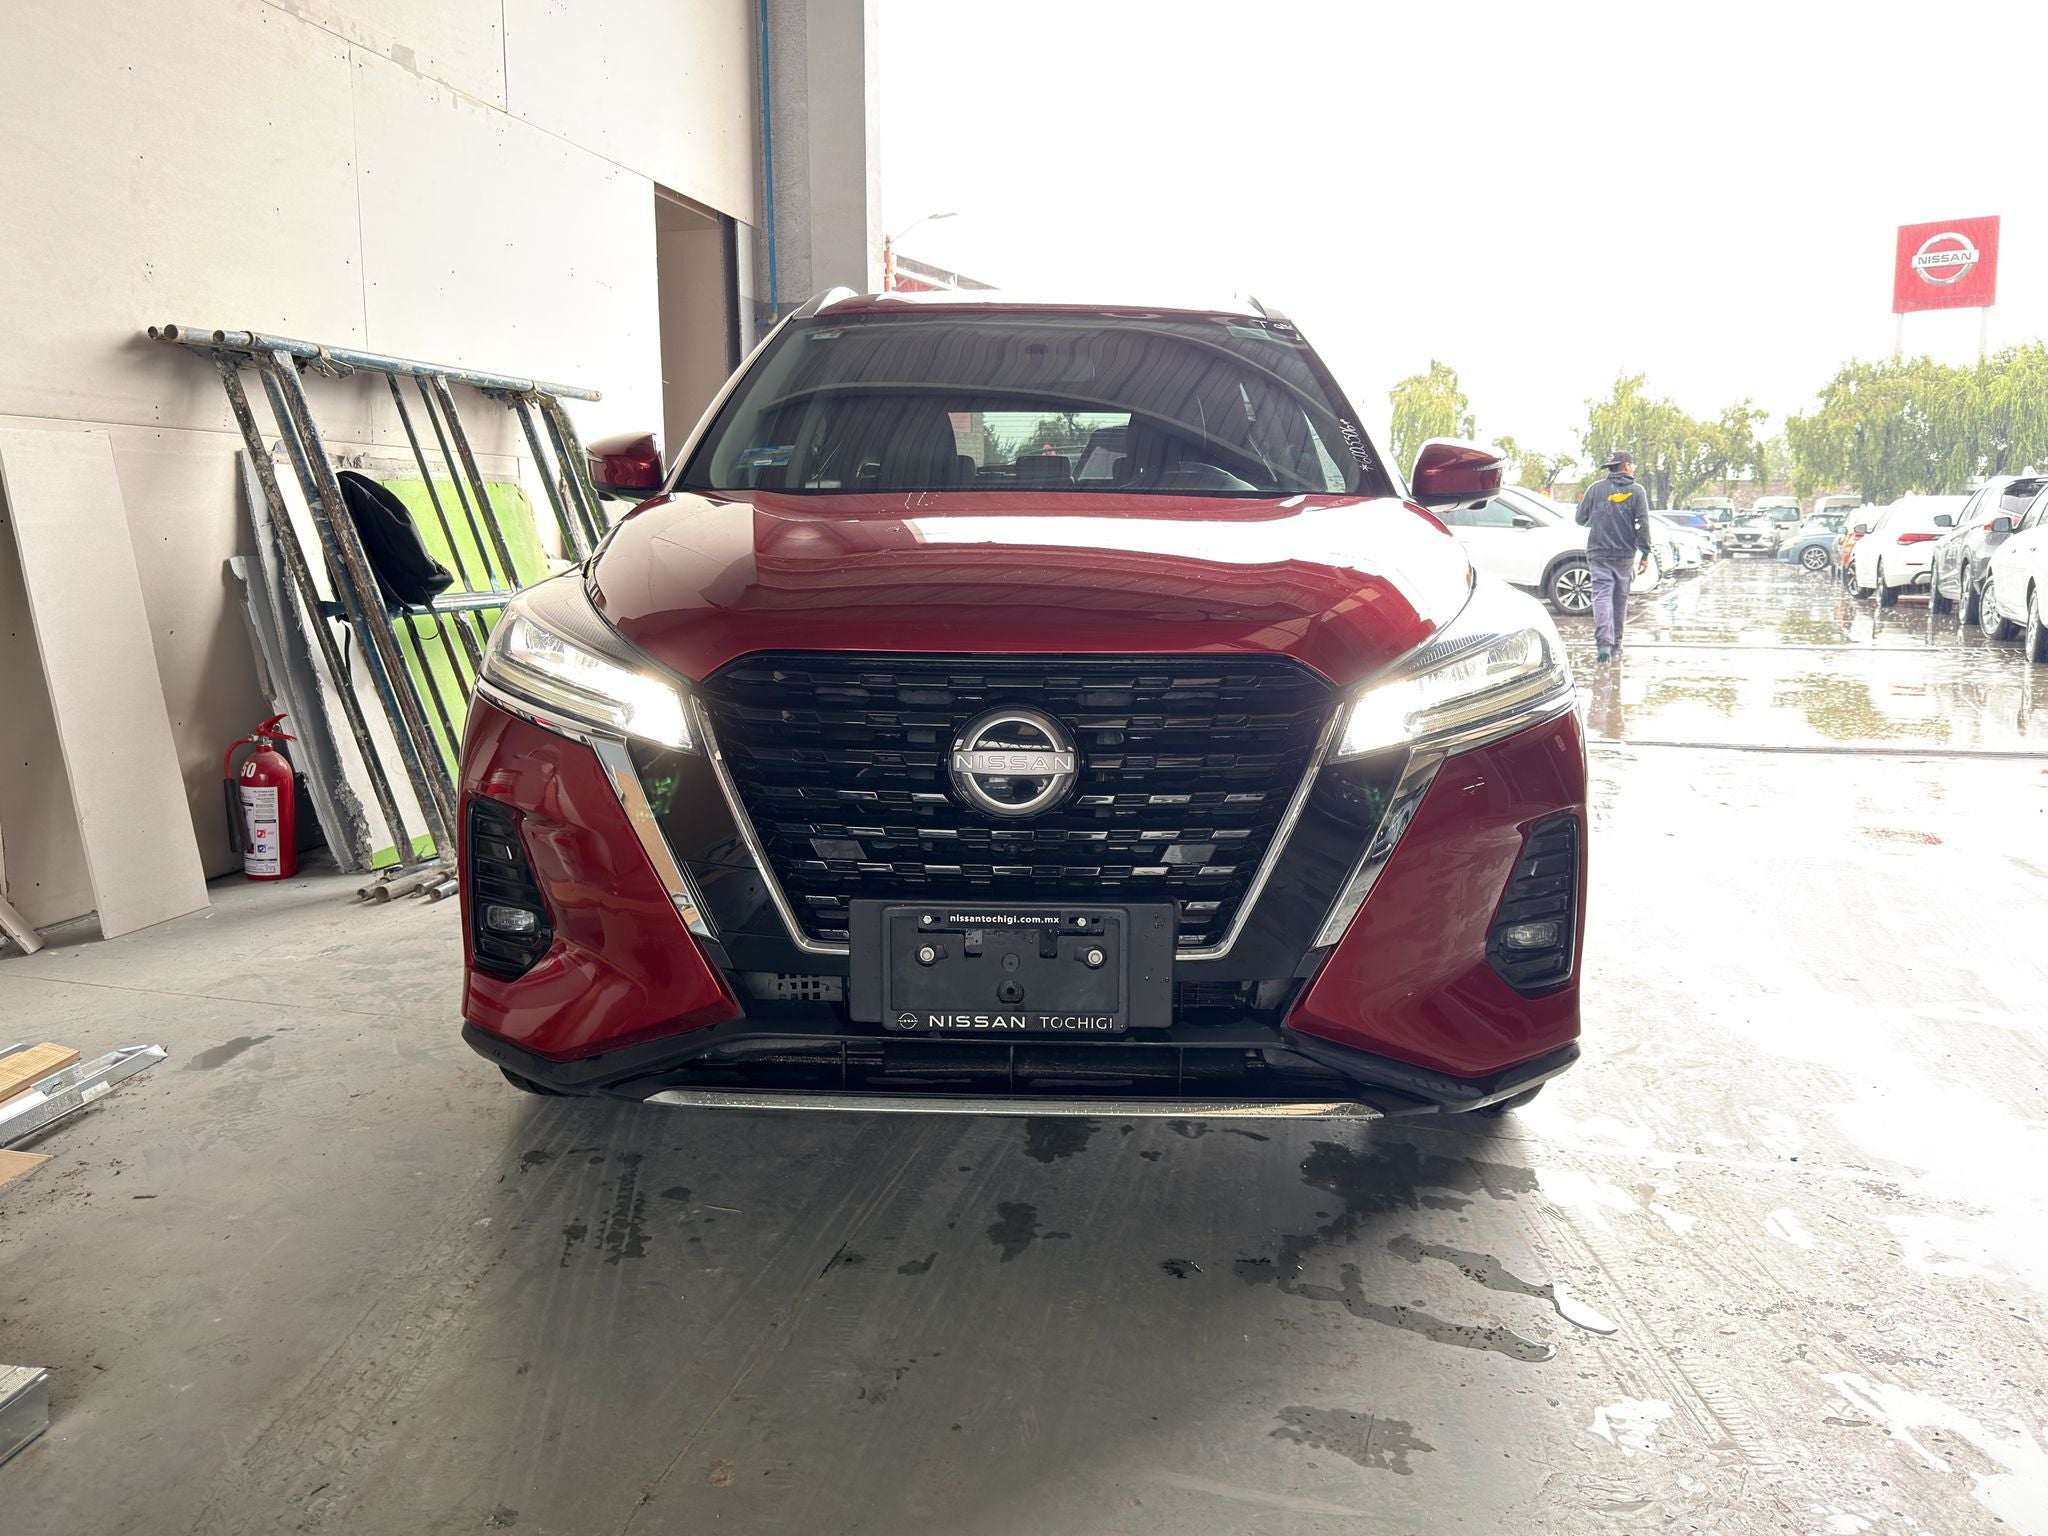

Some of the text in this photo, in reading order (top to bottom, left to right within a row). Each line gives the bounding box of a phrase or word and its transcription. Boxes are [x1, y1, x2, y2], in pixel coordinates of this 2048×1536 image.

[1918, 252, 1972, 265] NISSAN
[956, 754, 1071, 771] NISSAN
[949, 913, 1060, 925] nissantochigi.com.mx
[929, 1015, 1113, 1030] NISSAN TOCHIGI
